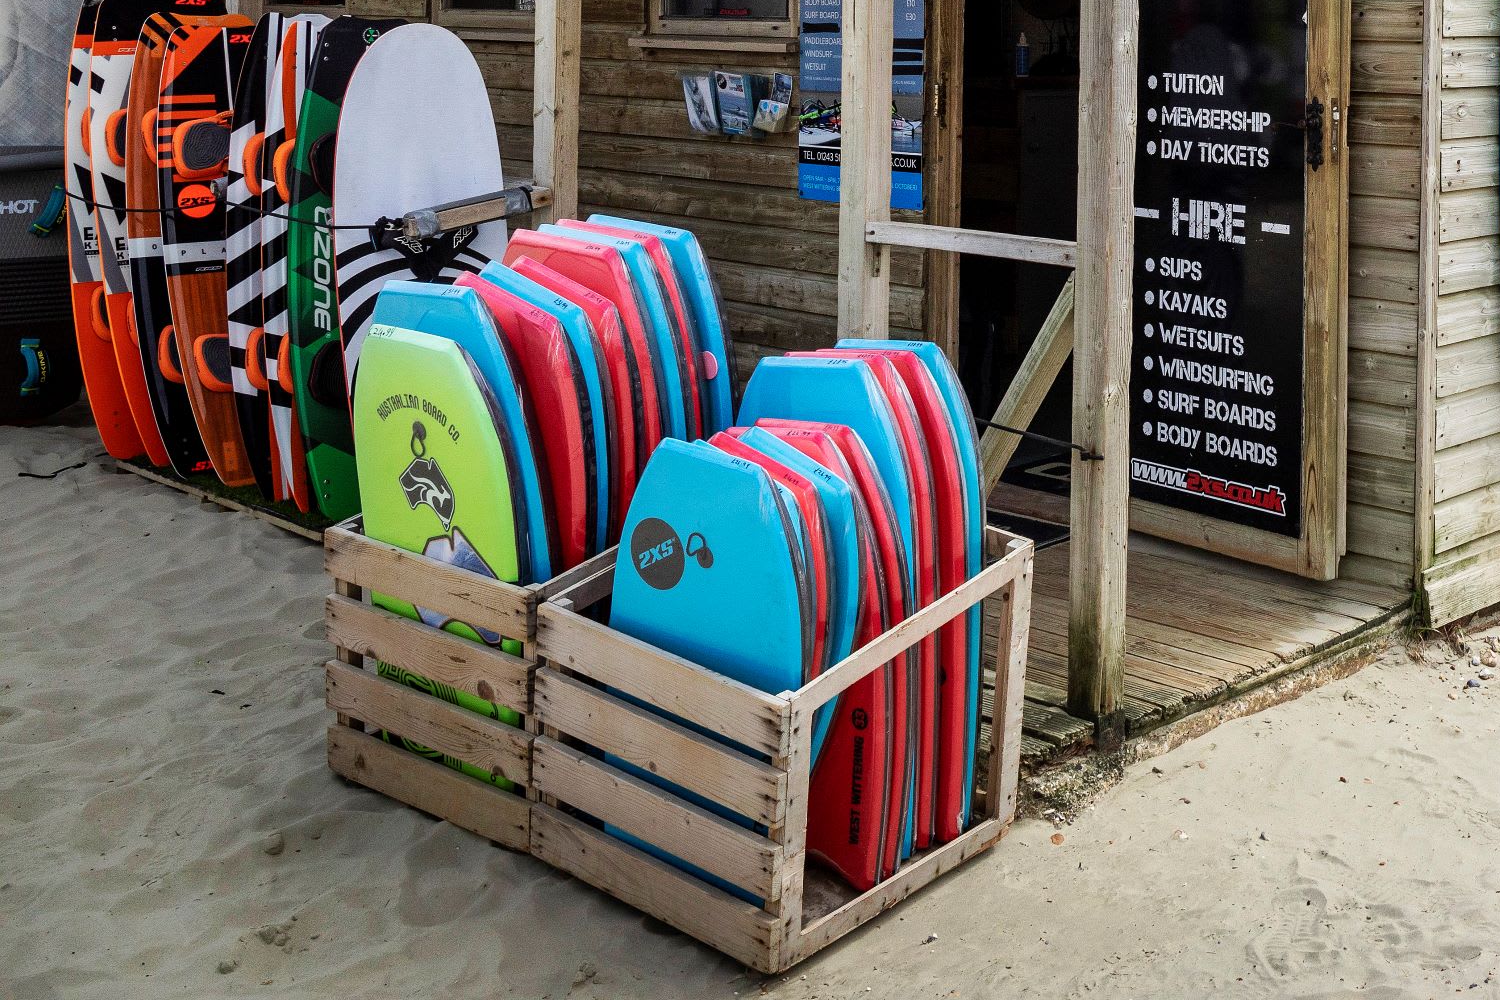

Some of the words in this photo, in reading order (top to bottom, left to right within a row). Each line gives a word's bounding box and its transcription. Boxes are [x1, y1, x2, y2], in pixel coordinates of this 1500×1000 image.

[230, 35, 251, 43] 2X
[805, 50, 833, 58] WINDSURF
[805, 63, 826, 71] WETSUIT
[1162, 73, 1224, 96] TUITION
[1161, 106, 1271, 133] MEMBERSHIP
[1160, 139, 1193, 161] DAY
[1198, 141, 1270, 168] TICKETS
[1171, 197, 1246, 245] HIRE
[1160, 256, 1202, 281] SUPS
[1159, 289, 1227, 319] KAYAKS
[1158, 322, 1244, 356] WETSUITS
[1158, 355, 1274, 396] WINDSURFING
[377, 394, 420, 422] AUSTRALIAN
[422, 399, 447, 427] BOARD
[448, 424, 460, 445] CO.
[1158, 389, 1199, 415] SURF
[1204, 398, 1276, 432] BOARDS
[1157, 421, 1201, 450] BODY
[1205, 432, 1278, 467] BOARDS
[1133, 460, 1284, 514] www.2xs.co.uk
[848, 808, 860, 844] WEST
